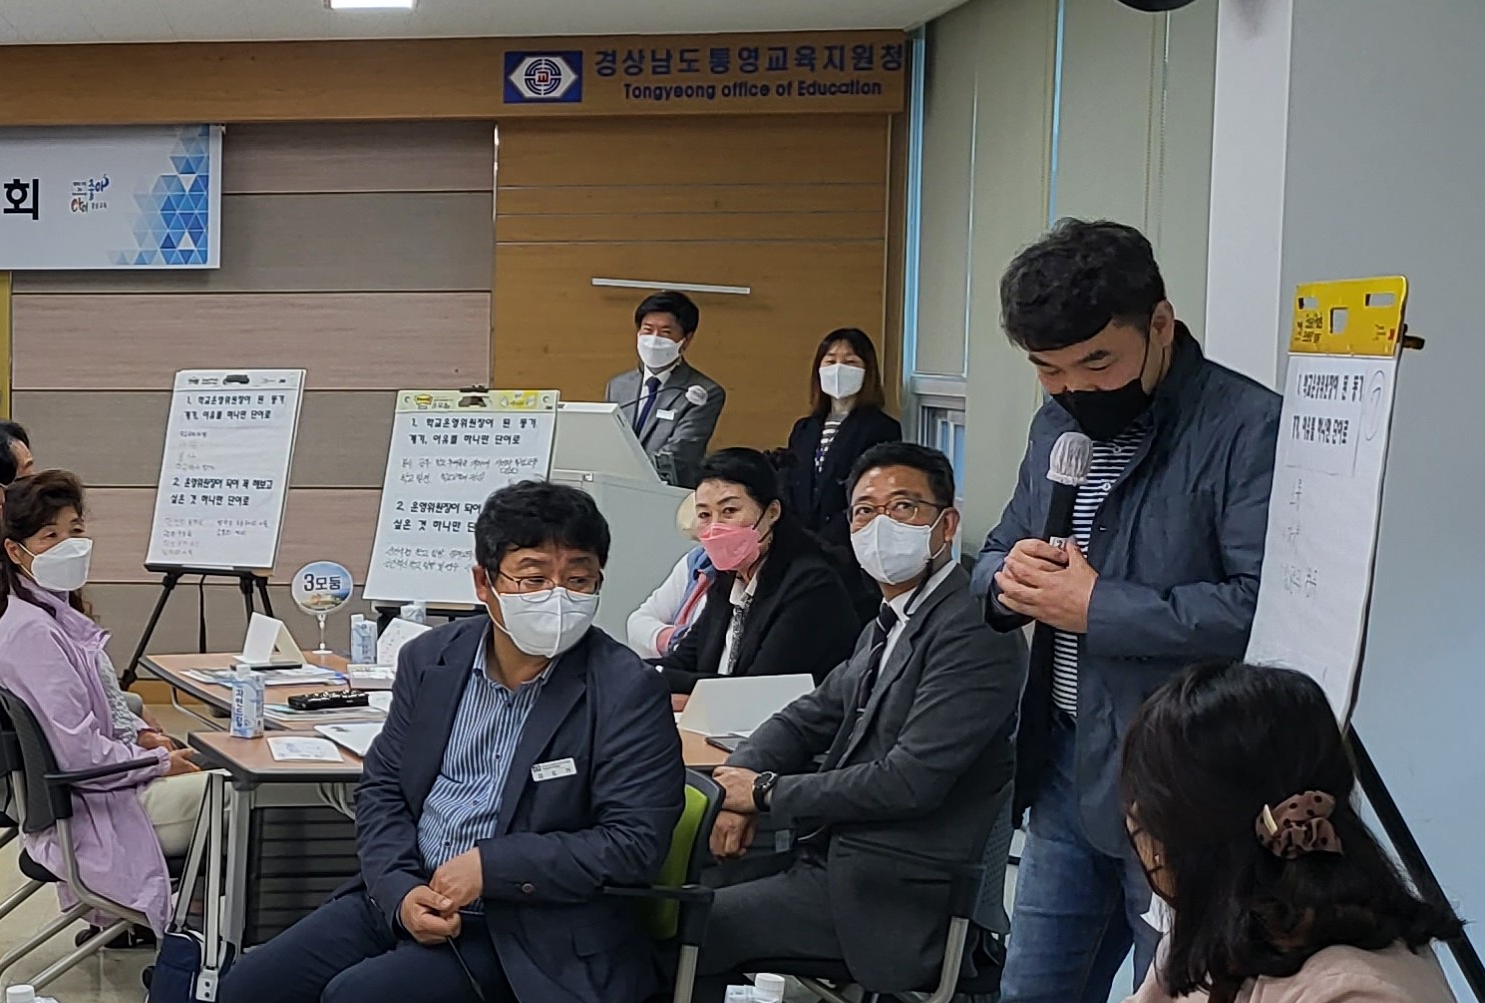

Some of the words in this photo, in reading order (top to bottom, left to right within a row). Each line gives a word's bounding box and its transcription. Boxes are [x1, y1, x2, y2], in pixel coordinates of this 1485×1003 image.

[595, 43, 904, 77] 경상남도통영교육지원청
[624, 84, 716, 101] Tongyeong
[722, 81, 770, 98] office
[776, 81, 793, 97] of
[798, 80, 882, 97] Education
[304, 573, 341, 592] 3모둠
